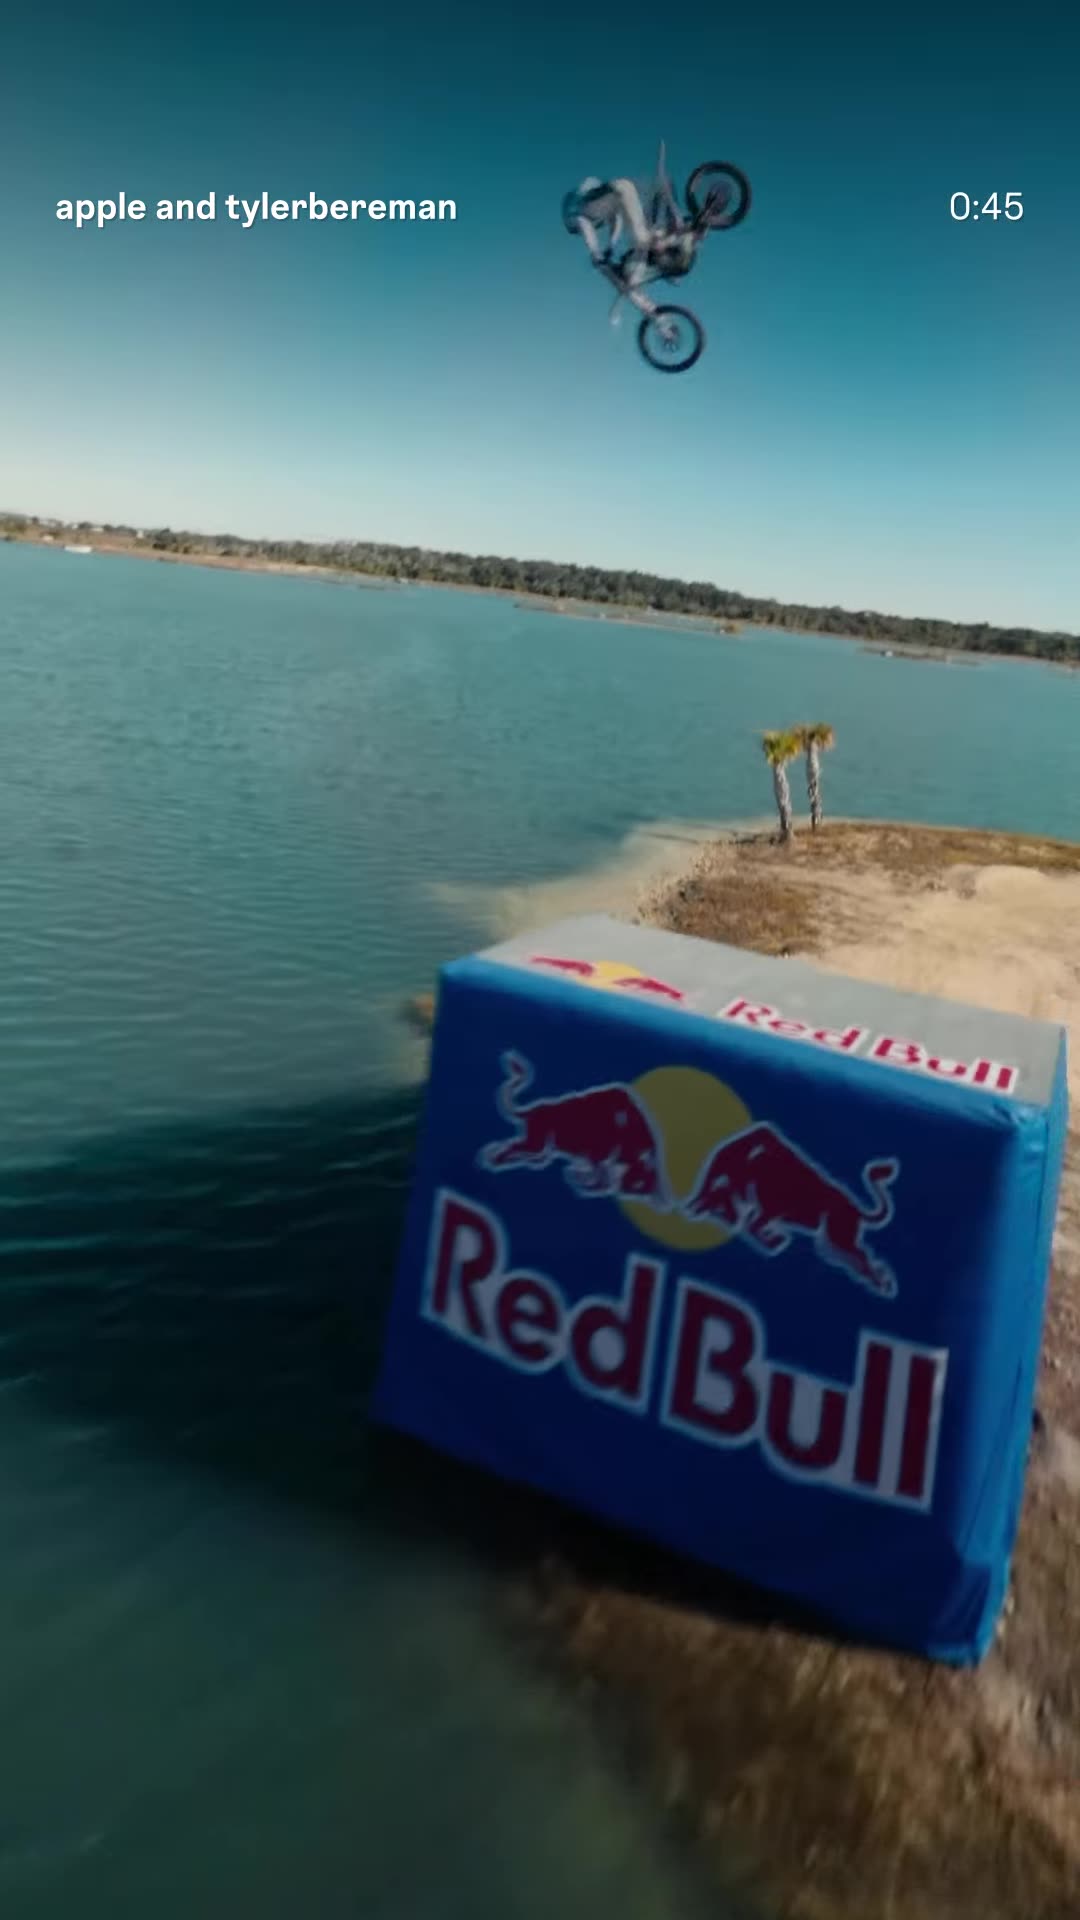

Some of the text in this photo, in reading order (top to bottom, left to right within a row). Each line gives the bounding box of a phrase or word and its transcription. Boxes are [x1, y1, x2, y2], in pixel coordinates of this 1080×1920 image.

[722, 998, 1016, 1093] Red Bull
[425, 1192, 946, 1509] Red Bull
